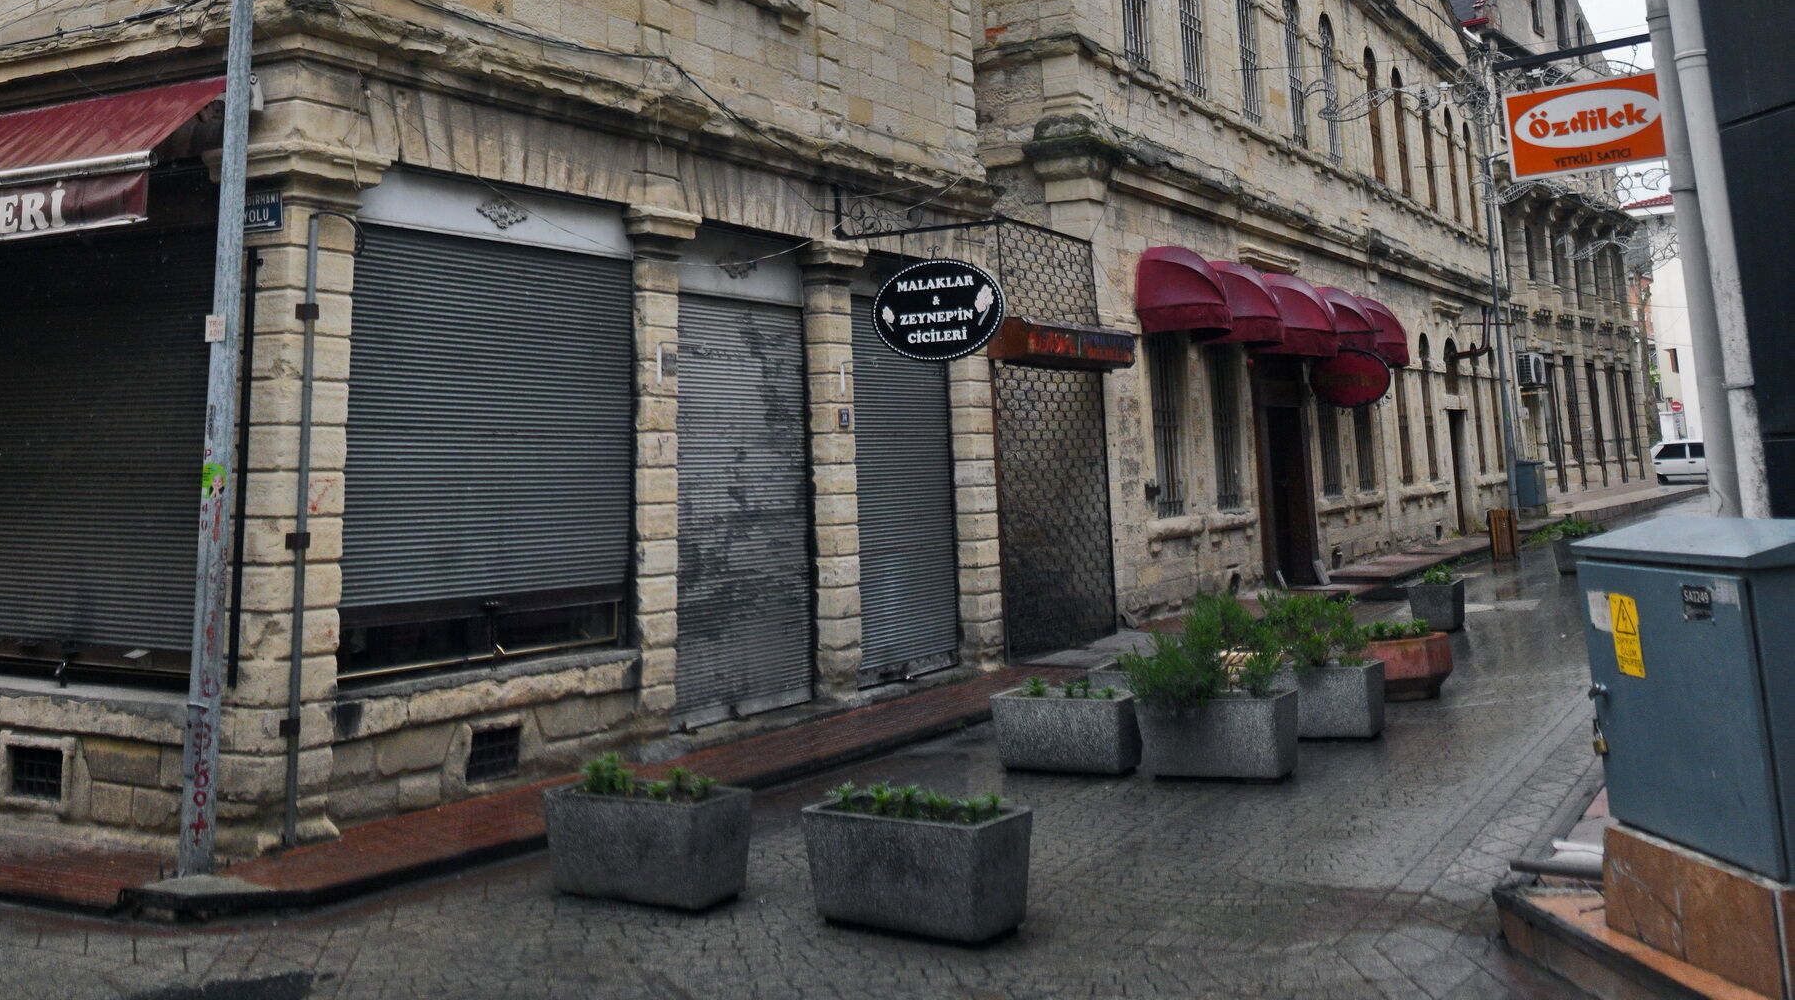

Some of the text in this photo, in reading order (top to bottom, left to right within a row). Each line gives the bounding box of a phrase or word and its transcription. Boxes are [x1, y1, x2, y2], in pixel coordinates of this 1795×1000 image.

[1528, 102, 1649, 139] Özdilek
[896, 274, 975, 293] MALAKLAR
[932, 295, 941, 306] &
[907, 326, 968, 344] CİCİLERİ
